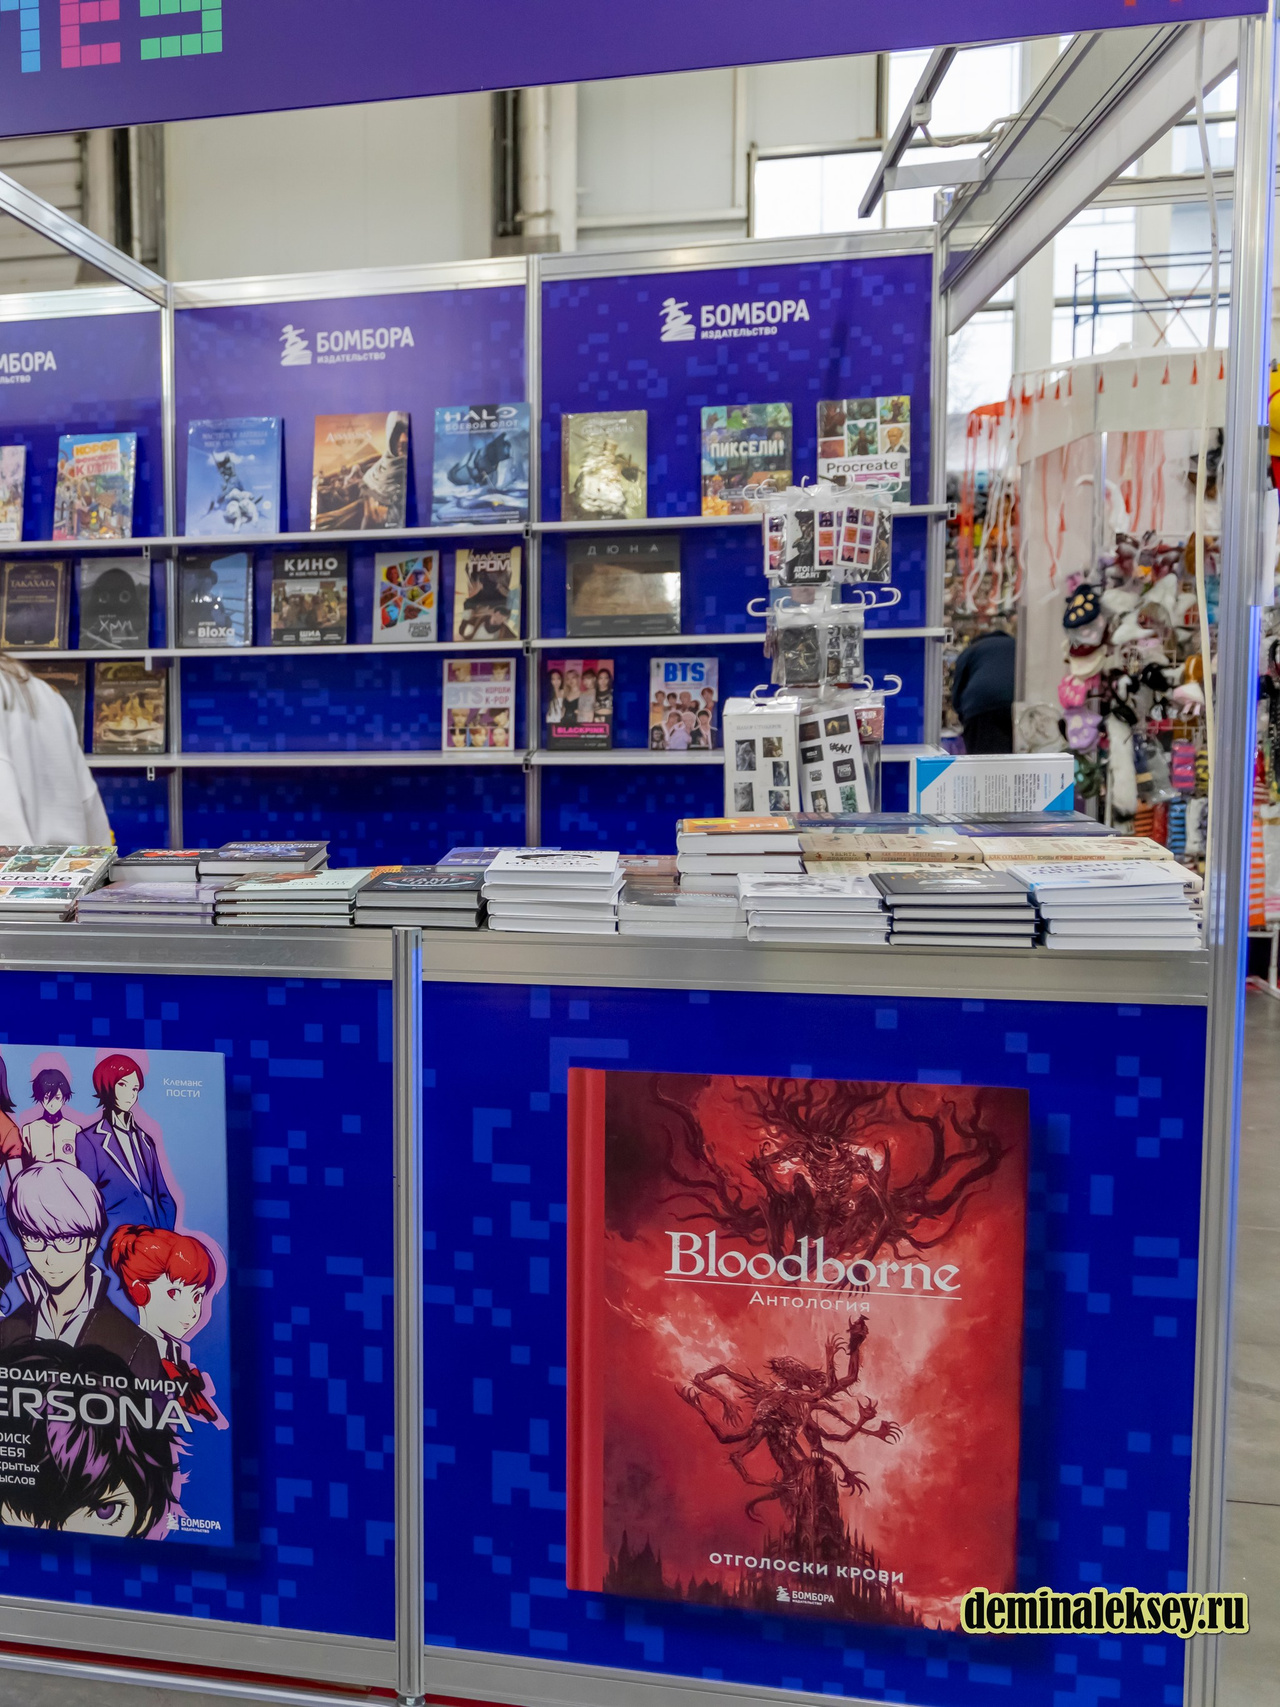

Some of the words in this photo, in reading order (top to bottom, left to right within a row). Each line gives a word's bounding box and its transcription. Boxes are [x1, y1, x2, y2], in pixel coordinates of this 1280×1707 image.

[701, 299, 810, 328] БОМБОРА
[316, 326, 415, 354] БОМБОРА
[701, 326, 778, 340] ИЗДАТЕЛЬСТВО
[317, 351, 386, 364] ИЗДАТЕЛЬСТВО
[710, 440, 785, 458] ПИКСЕЛИ!
[826, 459, 899, 475] Procreate
[284, 558, 338, 572] КИНО
[470, 560, 511, 572] ГРОМ
[664, 662, 705, 683] BTS
[447, 686, 484, 705] BTS
[485, 686, 511, 694] КОРОЛИ
[485, 696, 510, 705] K-POP
[557, 726, 605, 734] BLACKPINK
[163, 1077, 203, 1088] Клеманс
[166, 1089, 201, 1099] ПОСТИ
[665, 1229, 962, 1292] Bloodborne
[749, 1290, 871, 1313] Антология
[102, 1375, 129, 1389] по
[134, 1378, 189, 1396] миру
[180, 1517, 222, 1530] БОМБОРА
[709, 1551, 829, 1578] ОТГОЛОСКИ
[835, 1564, 904, 1585] КРОВИ
[792, 1590, 835, 1603] БОМБОРА
